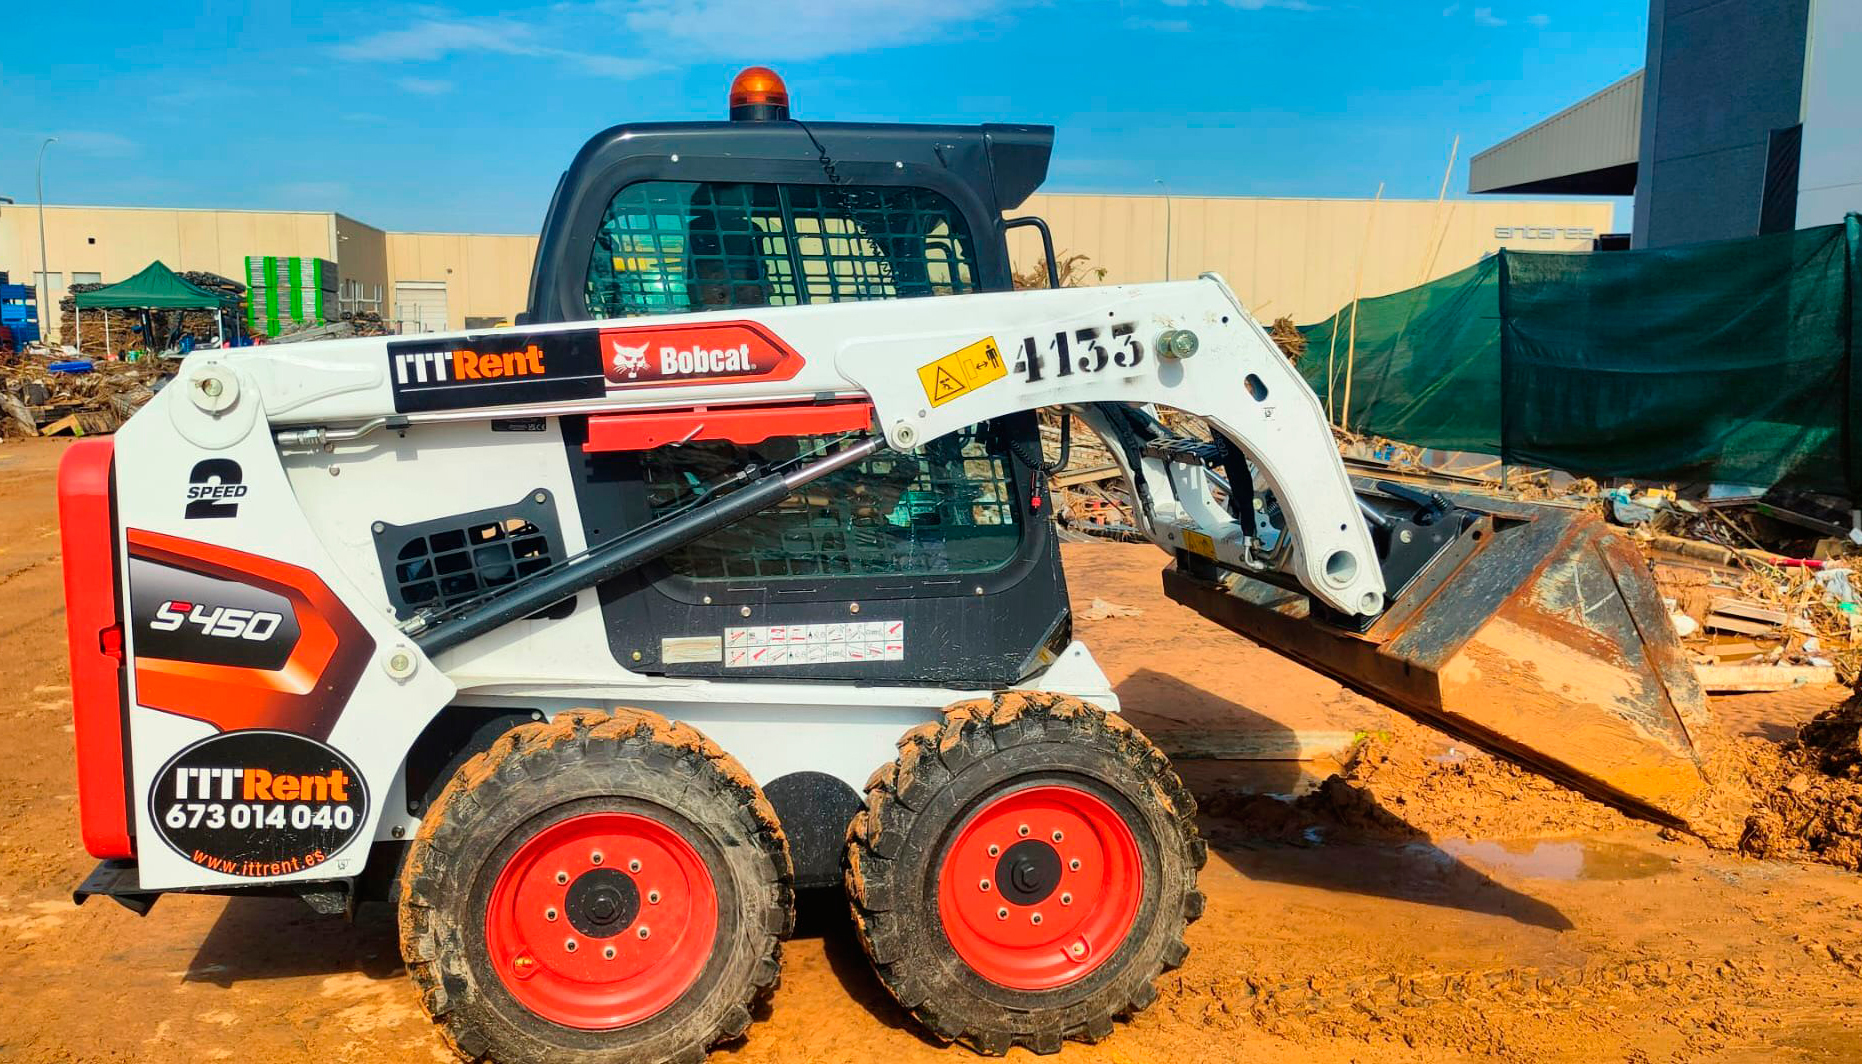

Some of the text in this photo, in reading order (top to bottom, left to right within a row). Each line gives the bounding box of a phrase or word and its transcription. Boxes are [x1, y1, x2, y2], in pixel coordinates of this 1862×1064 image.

[1495, 226, 1594, 240] antares
[660, 343, 751, 375] Bobcat
[1013, 322, 1145, 383] 4133
[184, 458, 243, 519] 2
[187, 485, 248, 499] SPEED
[150, 601, 283, 641] S450
[165, 803, 354, 830] 673 014 040
[192, 849, 326, 877] www.ittrent.es
